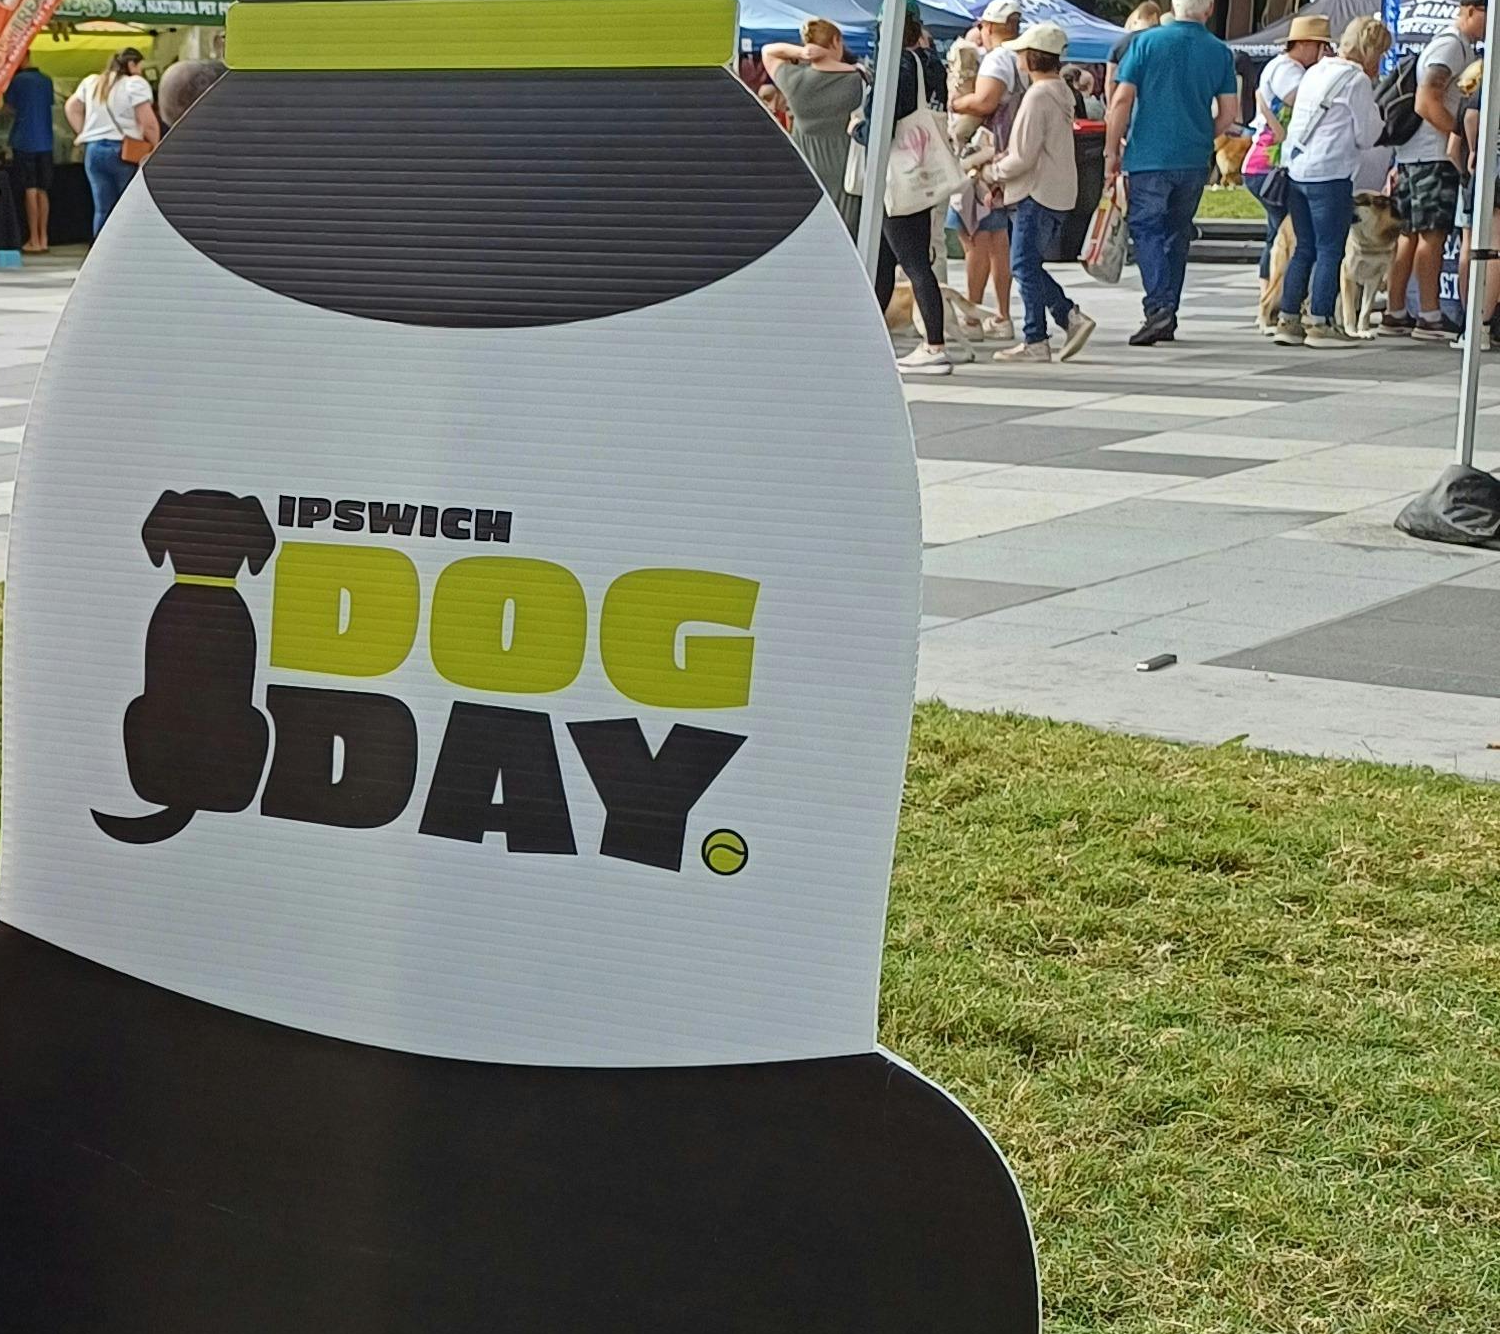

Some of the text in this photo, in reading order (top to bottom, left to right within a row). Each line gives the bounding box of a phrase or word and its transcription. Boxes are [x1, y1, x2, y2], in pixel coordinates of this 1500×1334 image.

[147, 0, 198, 15] NATURAL
[199, 1, 218, 16] PET
[278, 495, 513, 543] IPSWICH
[269, 540, 761, 709] DOG
